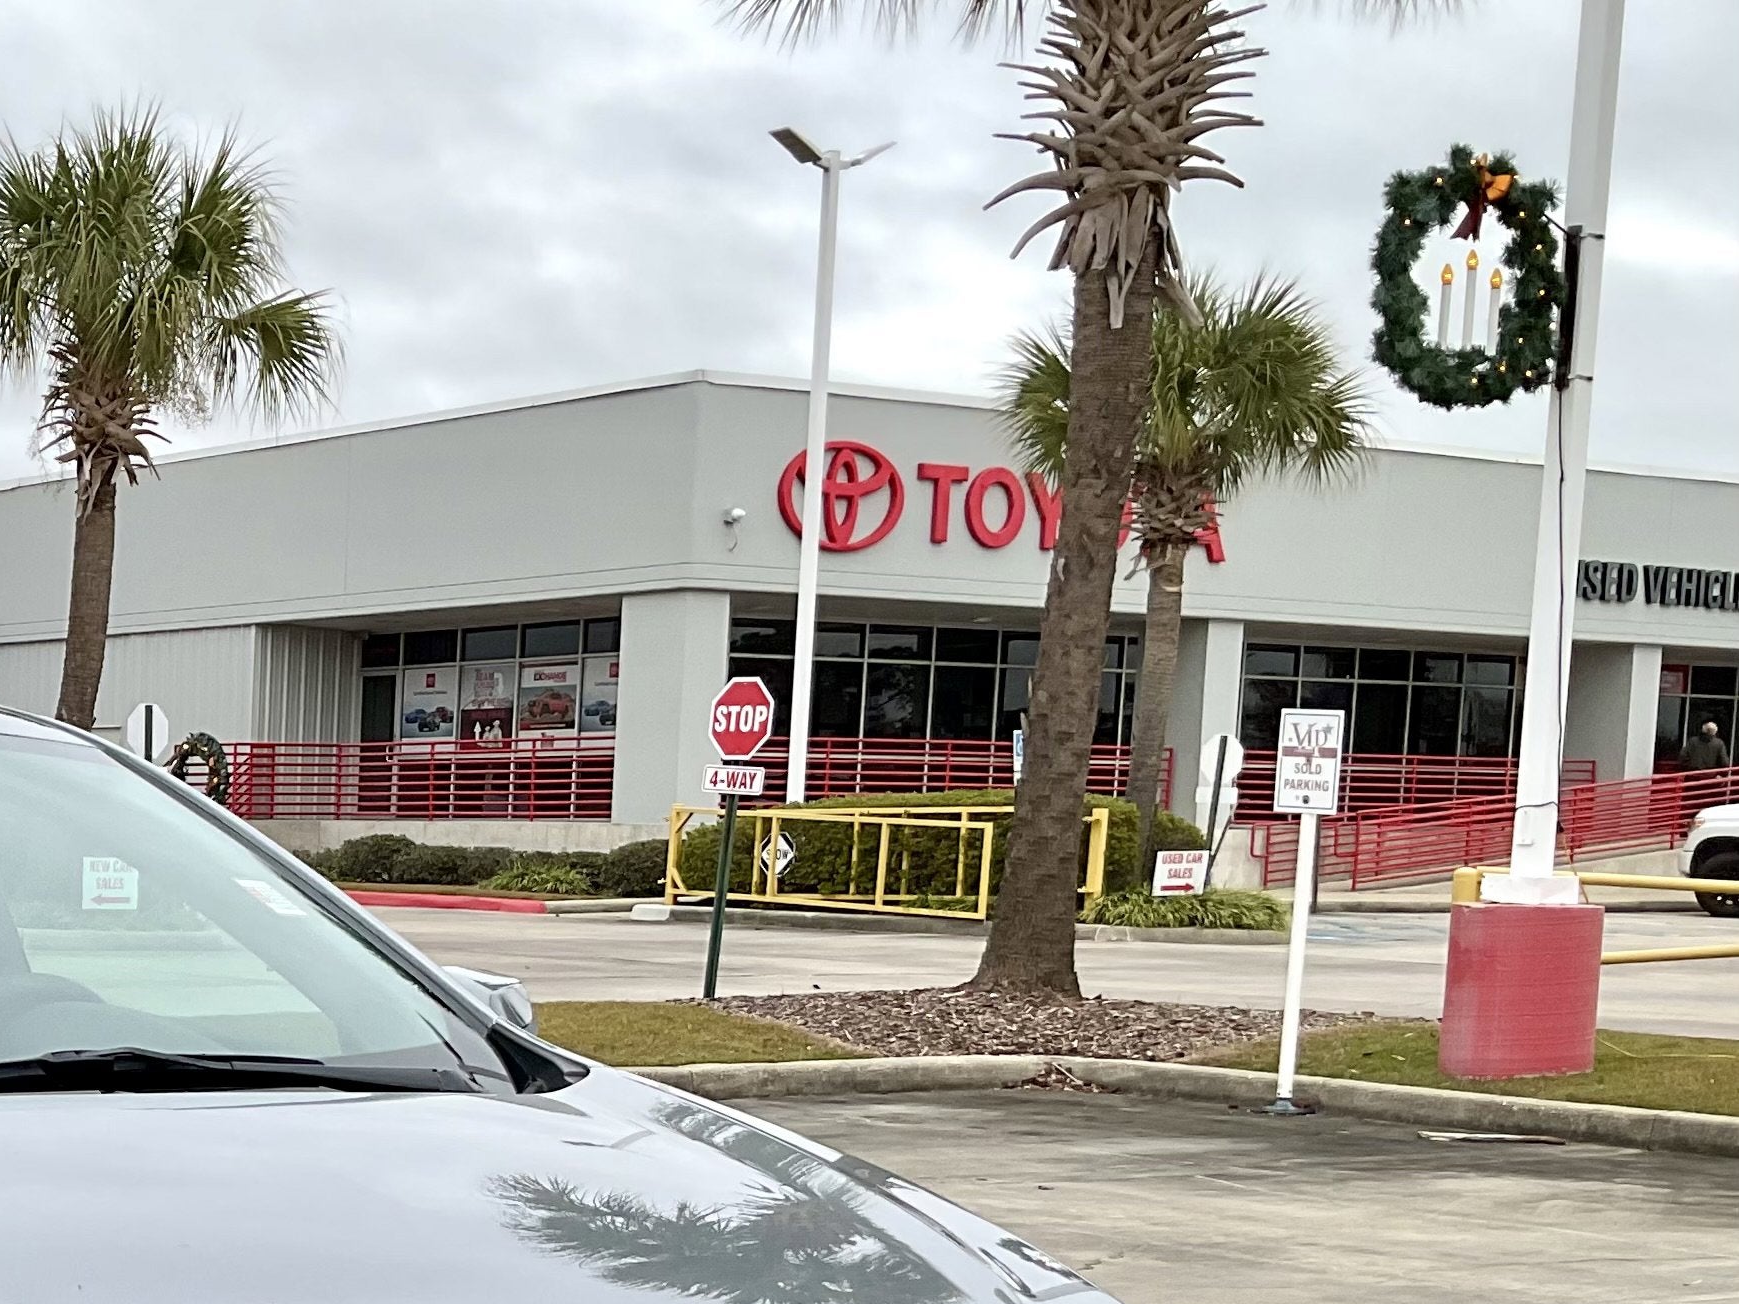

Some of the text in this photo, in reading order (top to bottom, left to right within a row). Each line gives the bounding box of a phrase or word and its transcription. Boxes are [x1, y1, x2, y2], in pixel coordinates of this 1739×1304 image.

[917, 462, 1226, 563] TOYA
[1643, 565, 1739, 611] VEHICL
[714, 704, 768, 733] STOP
[1294, 763, 1322, 775] SOLD
[710, 770, 757, 790] 4-WAY
[1284, 778, 1329, 792] PARKING
[766, 848, 791, 861] SOW
[1161, 852, 1203, 865] USED CAR
[89, 860, 110, 872] NEW
[1167, 867, 1193, 879] SALES
[95, 877, 124, 890] SALES
